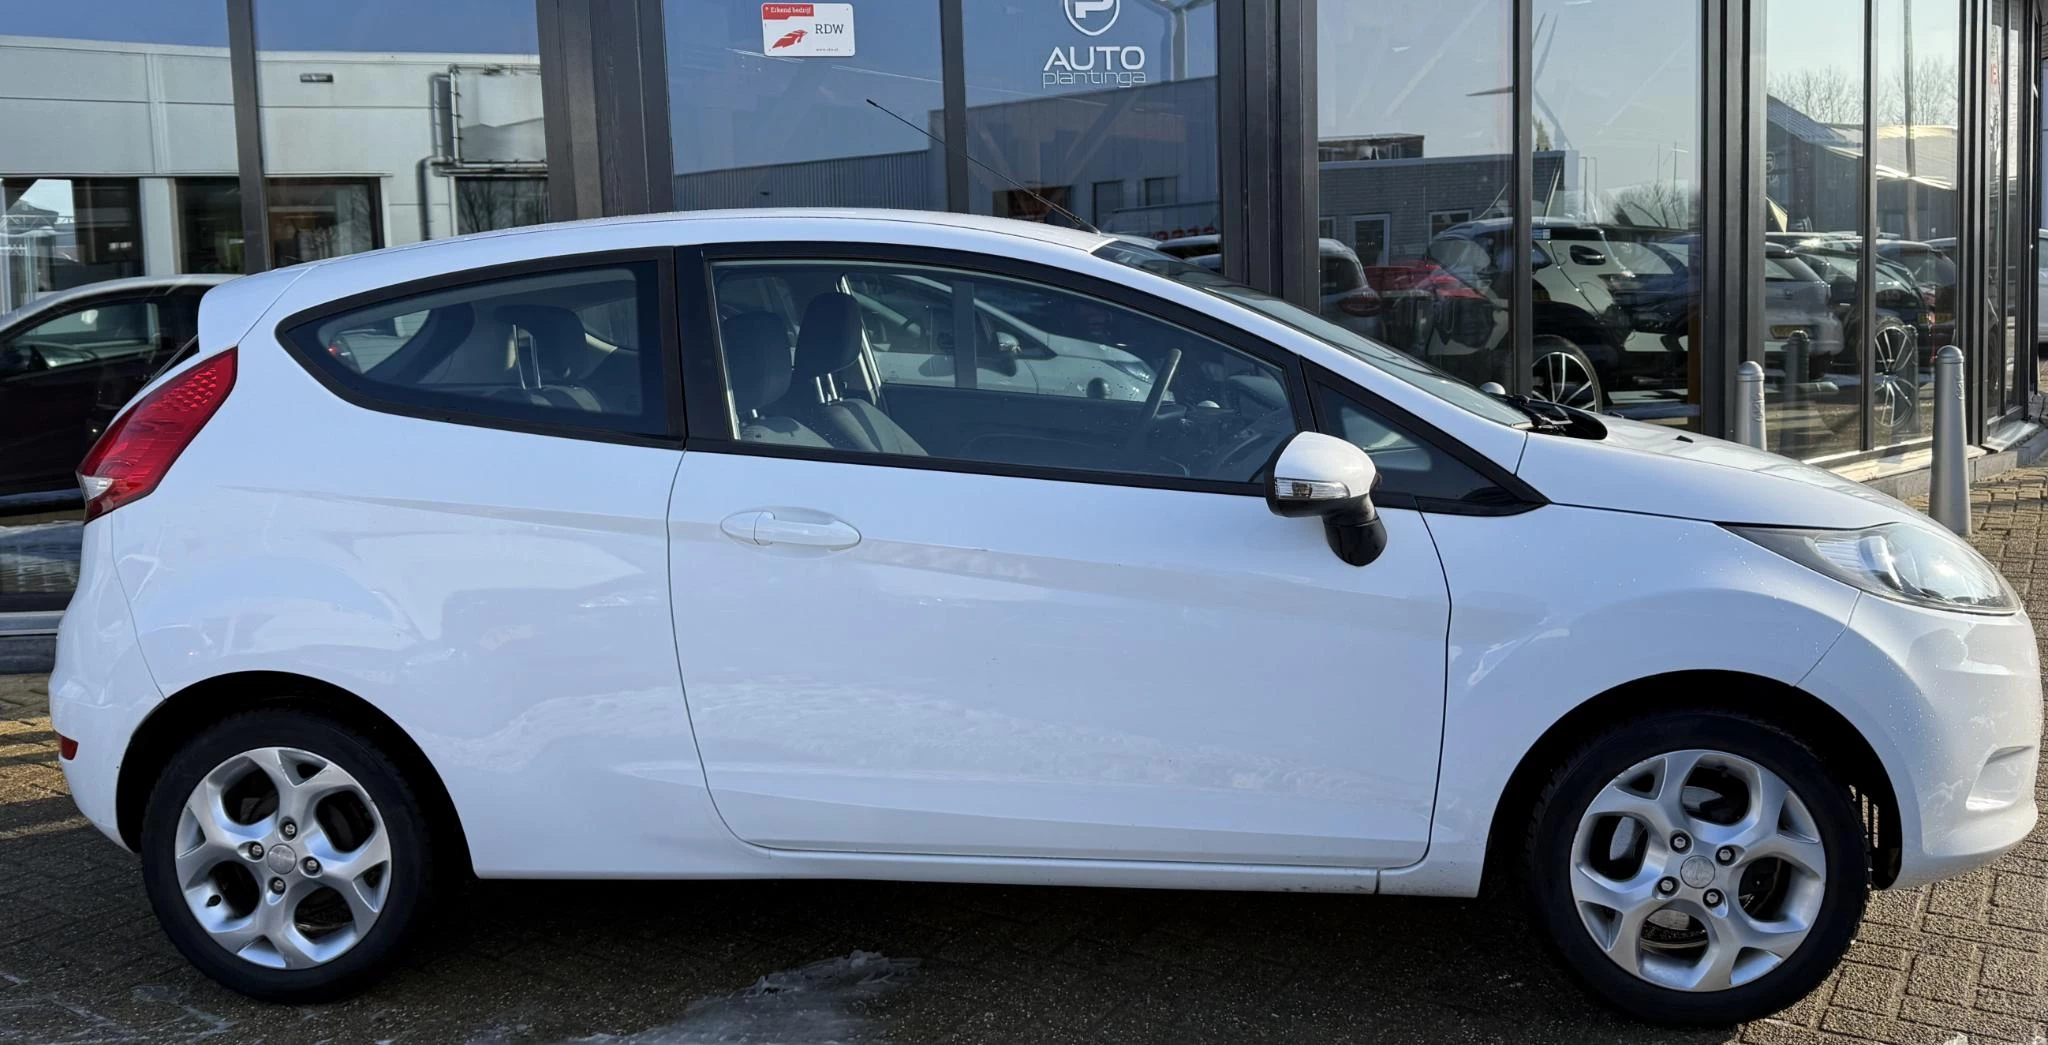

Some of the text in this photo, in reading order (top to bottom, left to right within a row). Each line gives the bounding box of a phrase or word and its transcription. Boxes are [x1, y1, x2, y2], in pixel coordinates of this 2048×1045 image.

[792, 6, 811, 15] bedrijf
[815, 24, 844, 34] RDW
[1043, 46, 1146, 71] AUTO
[1042, 69, 1146, 88] plantinga
